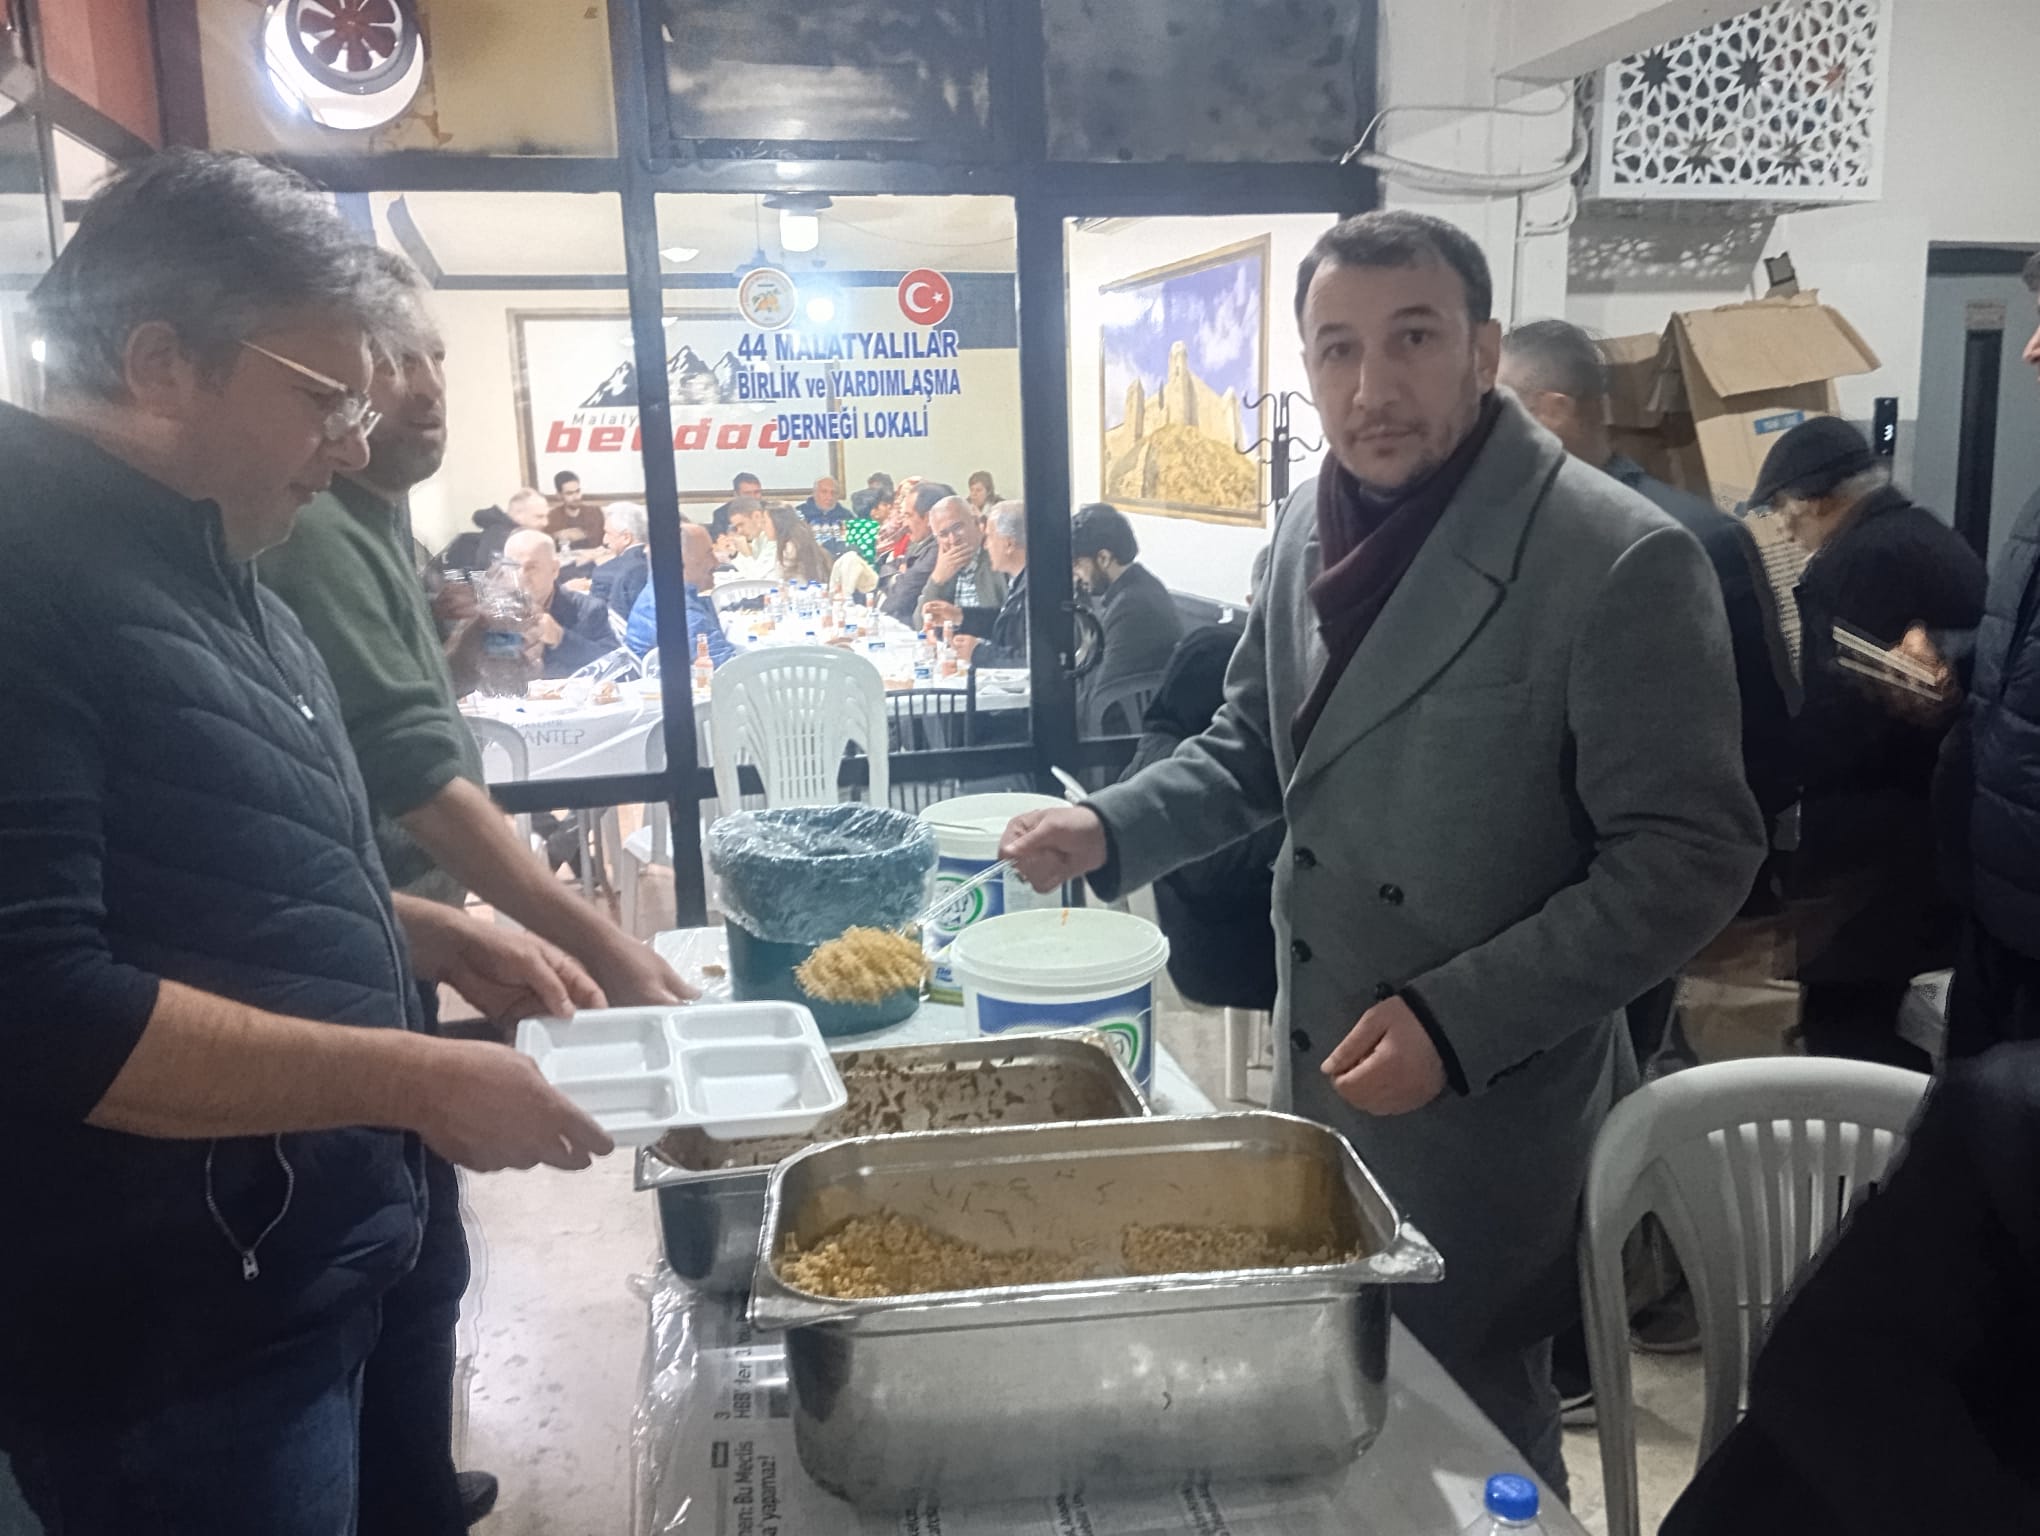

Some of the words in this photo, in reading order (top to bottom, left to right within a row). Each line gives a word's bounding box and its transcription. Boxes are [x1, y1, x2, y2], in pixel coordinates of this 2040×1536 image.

[738, 334, 767, 361] 44
[775, 332, 959, 360] MALATYALILAR
[738, 365, 801, 399] BİRLİK
[806, 378, 826, 398] ve
[832, 369, 961, 402] YARDIMLAŞMA
[572, 413, 640, 427] Malaty
[778, 406, 858, 440] DERNEĞİ
[864, 405, 928, 438] LOKALİ
[1884, 424, 1894, 441] 3
